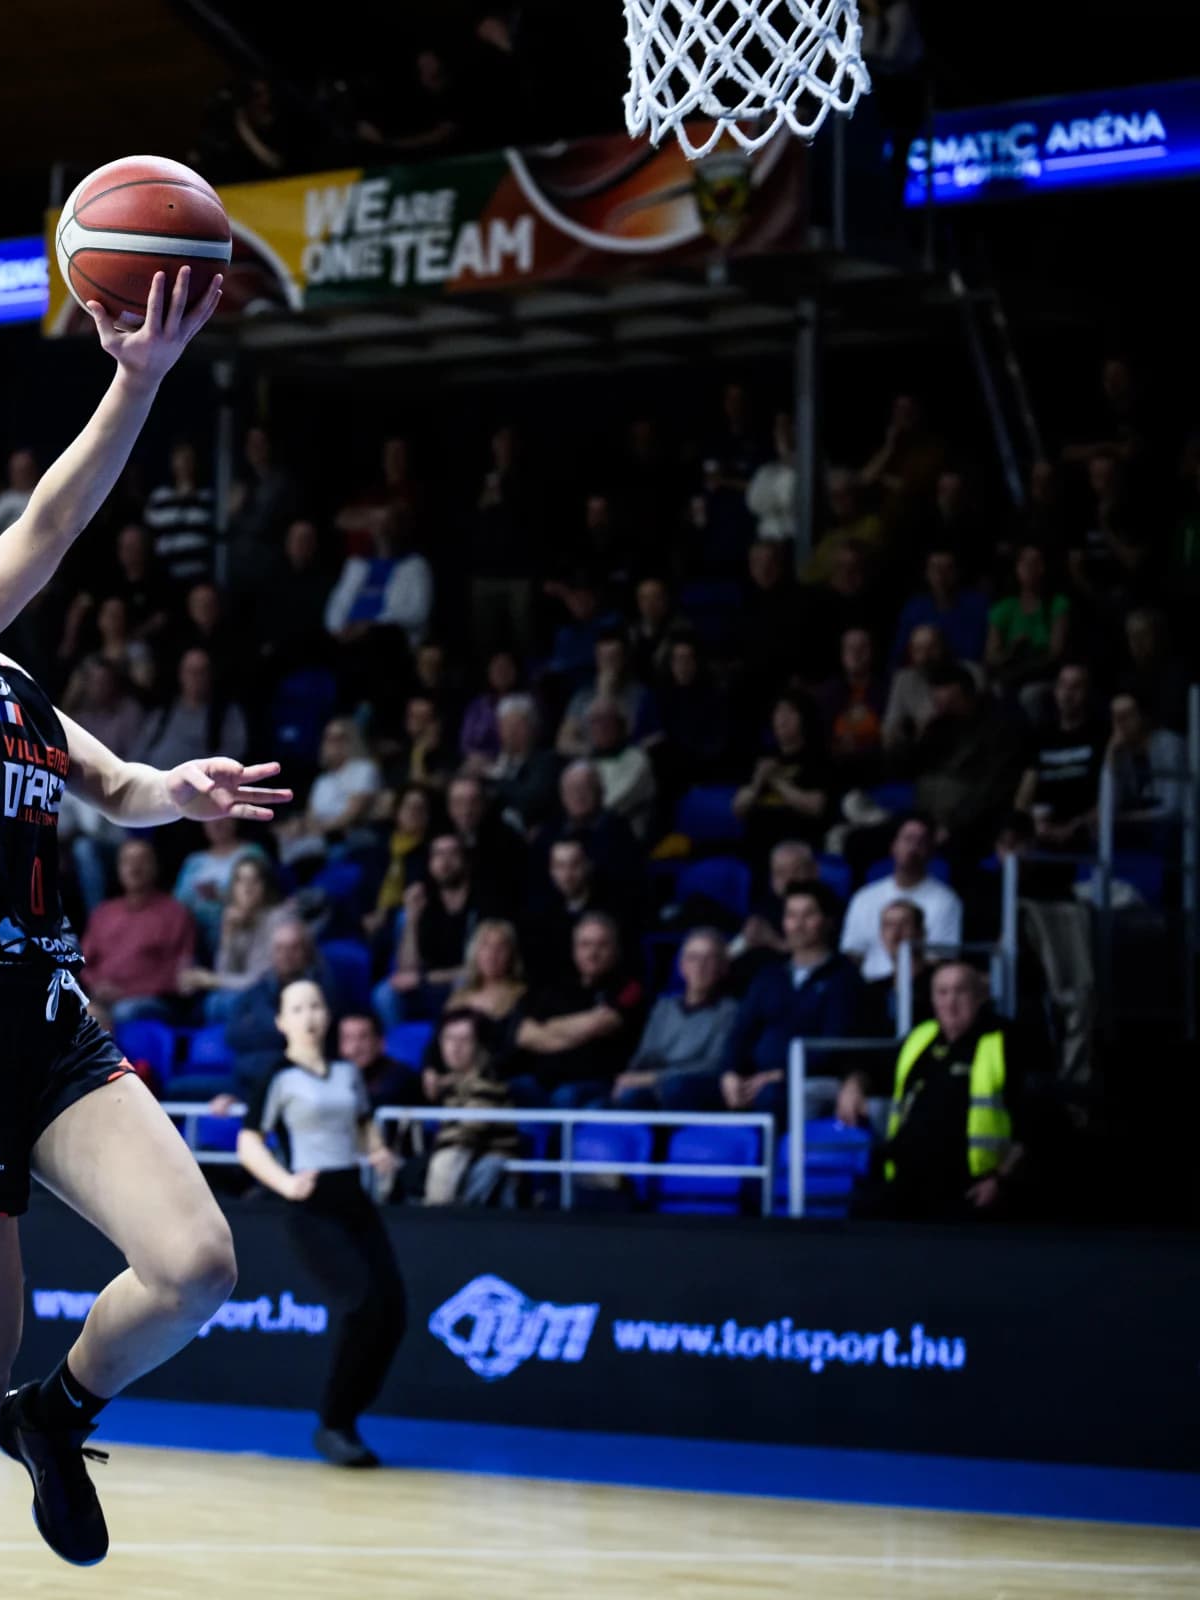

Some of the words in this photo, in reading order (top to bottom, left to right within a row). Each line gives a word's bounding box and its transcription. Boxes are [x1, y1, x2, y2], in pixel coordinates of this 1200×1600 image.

[304, 178, 392, 239] WE
[387, 188, 457, 224] ARE
[386, 215, 536, 287] TEAM
[613, 1318, 967, 1373] www.totisport.hu
